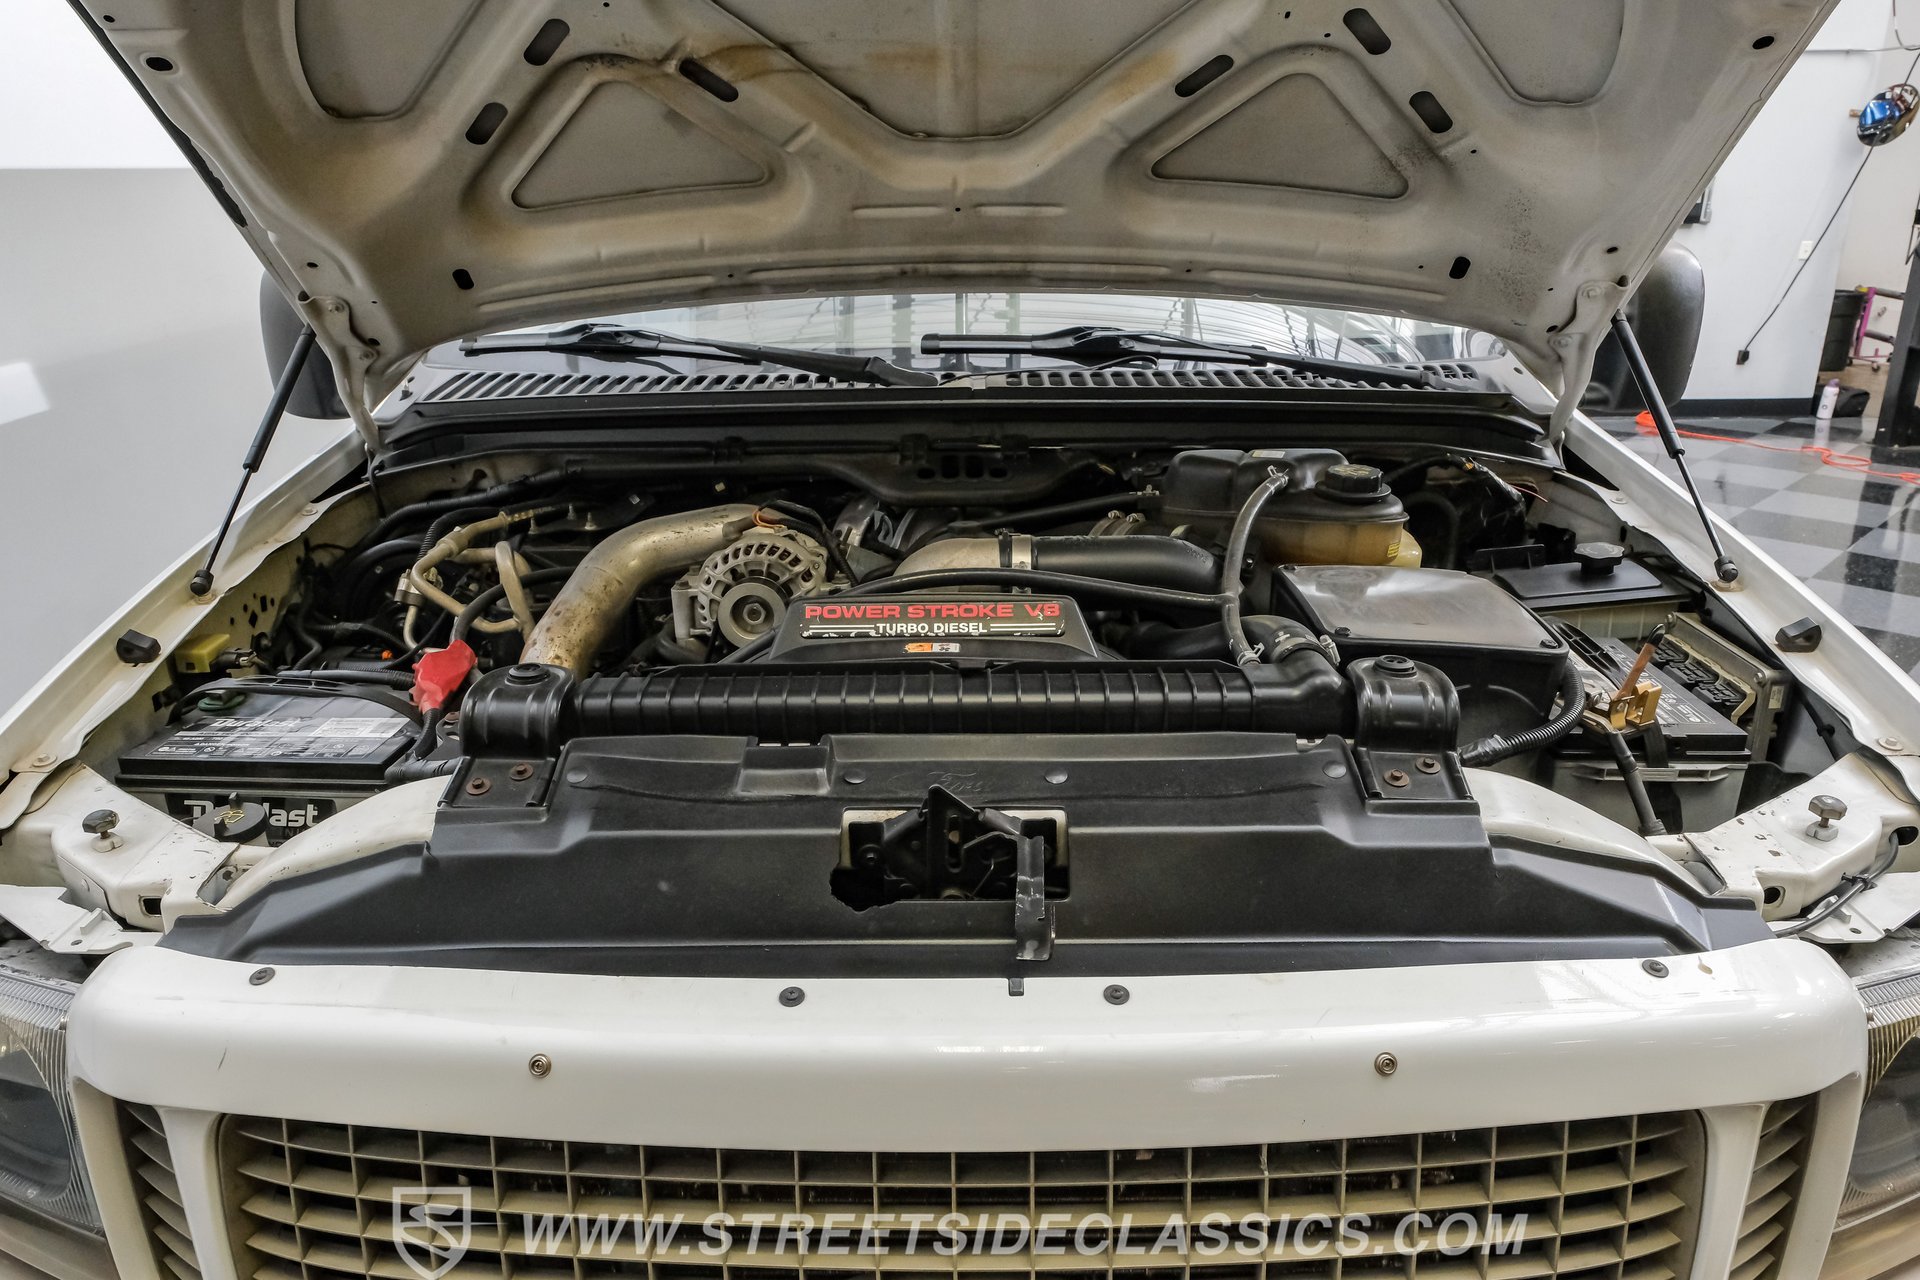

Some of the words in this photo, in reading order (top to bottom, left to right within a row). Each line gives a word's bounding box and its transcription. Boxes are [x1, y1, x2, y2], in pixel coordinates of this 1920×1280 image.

[805, 605, 900, 619] POWER
[907, 604, 1014, 618] STROKE
[1023, 602, 1061, 617] V8
[876, 623, 929, 634] TURBO
[933, 622, 988, 633] DIESEL
